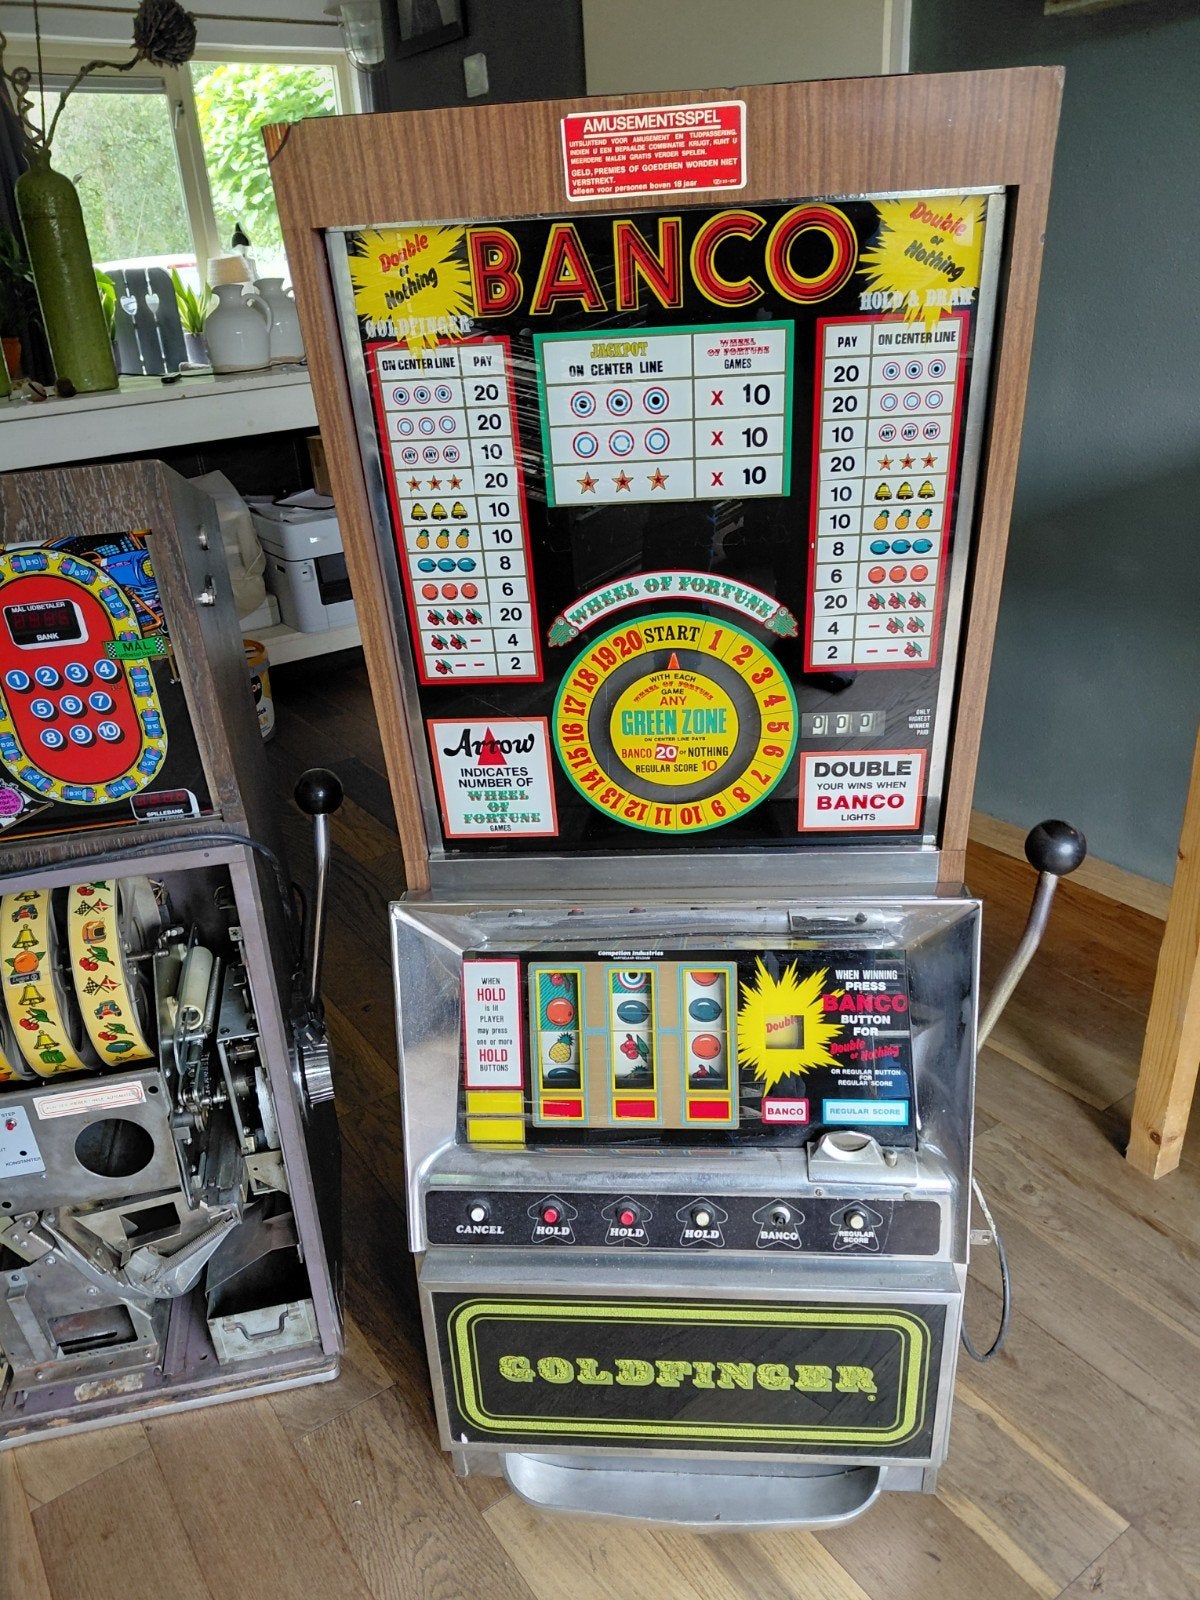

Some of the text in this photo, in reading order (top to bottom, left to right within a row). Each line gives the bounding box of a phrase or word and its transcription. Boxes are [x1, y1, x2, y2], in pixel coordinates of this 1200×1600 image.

[583, 109, 721, 133] AMUSEMENTSSPEL
[569, 139, 607, 147] UITSLUITEND
[632, 134, 670, 143] AMUSEMENT
[615, 145, 645, 153] BEPAALDE
[649, 141, 685, 150] COMBINATIE
[594, 166, 626, 175] PREMIES
[642, 162, 683, 172] GOEDEREN
[686, 159, 719, 168] WORDEN
[721, 158, 738, 166] NIET
[572, 176, 616, 186] VERSTREKT.
[573, 187, 594, 195] alleen
[615, 183, 647, 192] personen
[683, 180, 698, 188] jaar
[909, 201, 967, 237] Double
[379, 233, 429, 273] Double
[465, 202, 858, 318] BANCO
[904, 239, 965, 283] Nothing
[384, 267, 439, 311] Nothing
[859, 291, 902, 311] HOLD
[719, 337, 756, 348] WHEEL
[837, 336, 858, 348] PAY
[878, 331, 956, 346] ON CENTER LINE
[590, 341, 649, 359] JACKPOT
[707, 346, 770, 357] OF FORTUNE
[382, 357, 456, 371] ON CENTER LINE
[473, 356, 492, 367] PAY
[569, 360, 664, 377] ON CENTER LINE
[724, 358, 752, 370] GAMES
[833, 365, 859, 383] 20
[474, 384, 499, 401] 20
[742, 383, 771, 406] 10
[477, 414, 502, 430] 20
[741, 427, 768, 448] 10
[832, 426, 854, 442] 10
[425, 451, 437, 459] ANY
[445, 450, 457, 458] ANY
[481, 443, 503, 459] 10
[830, 456, 855, 472] 20
[489, 502, 510, 517] 10
[833, 542, 844, 556] 8
[500, 556, 512, 570] 8
[502, 582, 514, 596] 6
[11, 601, 66, 613] MÅL UDBETALER
[567, 576, 781, 625] WHEEL OF FORTUNE
[36, 633, 59, 641] BANK
[612, 629, 643, 651] 20
[643, 625, 701, 644] START
[708, 630, 723, 651] 1
[591, 646, 618, 672] 19
[731, 644, 754, 666] 2
[12, 670, 52, 686] 1 2
[572, 668, 599, 693] 18
[650, 673, 696, 682] WITH EACH
[564, 695, 587, 717] 17
[660, 696, 687, 706] ANY
[621, 708, 727, 736] GREEN ZONE
[100, 724, 117, 736] 10
[561, 722, 584, 743] 16
[443, 728, 535, 757] Arrow
[621, 746, 729, 759] BANCO 20 NOTHING
[460, 767, 528, 777] INDICATES
[635, 760, 718, 773] REGULAR SCORE 10
[814, 760, 912, 778] DOUBLE
[458, 778, 533, 788] NUMBER OF
[817, 781, 906, 791] YOUR WINS WHEN
[467, 790, 529, 801] WHEEL
[817, 793, 905, 811] BANCO
[146, 808, 184, 817] SPILLEBANK
[487, 802, 510, 812] OF
[463, 813, 541, 824] FORTUNE
[841, 813, 876, 821] LIGHTS
[489, 824, 512, 832] GAMES
[481, 977, 500, 985] WHEN
[835, 970, 898, 980] WHEN WINNING
[845, 982, 886, 991] PRESS
[477, 988, 506, 1002] HOLD
[822, 994, 908, 1012] BANCO
[480, 1015, 504, 1023] PLAYER
[841, 1015, 891, 1025] BUTTON
[477, 1027, 508, 1035] may press
[853, 1027, 878, 1036] FOR
[829, 1038, 866, 1055] Double
[860, 1045, 900, 1062] Nothing
[479, 1049, 508, 1063] HOLD
[480, 1064, 509, 1072] BUTTONS
[767, 1107, 804, 1116] BANCO
[830, 1107, 900, 1115] REGULAR SCORE
[456, 1225, 504, 1235] CANCEL
[536, 1226, 570, 1236] HOLD
[609, 1227, 644, 1238] HOLD
[684, 1229, 720, 1239] HOLD
[760, 1231, 799, 1241] BANCO
[838, 1230, 875, 1238] REGULAR
[499, 1355, 878, 1394] GOLDFINGER
